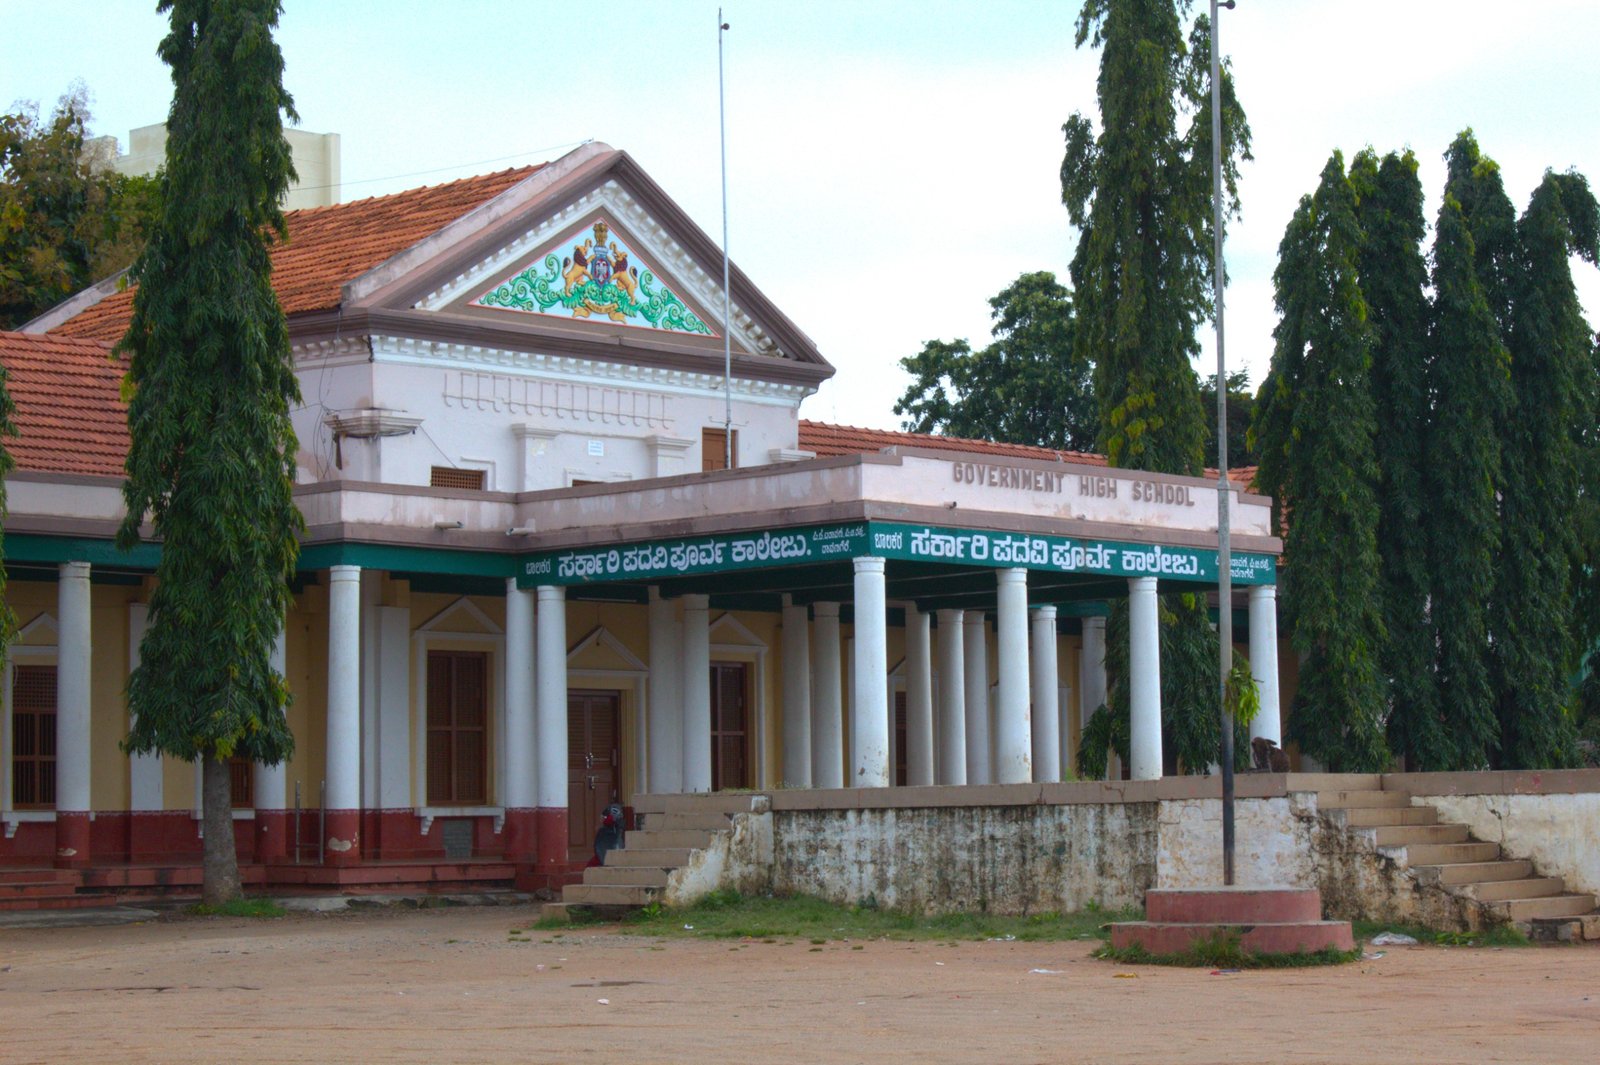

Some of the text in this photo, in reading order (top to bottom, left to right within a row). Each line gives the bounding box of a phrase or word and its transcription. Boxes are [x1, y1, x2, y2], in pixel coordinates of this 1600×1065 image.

[953, 462, 1195, 506] GOVERNMENT HIGH SCHOOL
[558, 550, 620, 577] ಸರ್ಕಾರಿ
[623, 545, 668, 572] ಪದವಿ
[670, 539, 727, 571] ಪೂರ್ವ
[874, 532, 903, 550] ಬಾಲಕರ
[911, 529, 989, 560] ಸರ್ಕಾರಿ
[993, 535, 1049, 565] ಪದವಿ
[1052, 541, 1117, 570] ಪೂರ್ವ
